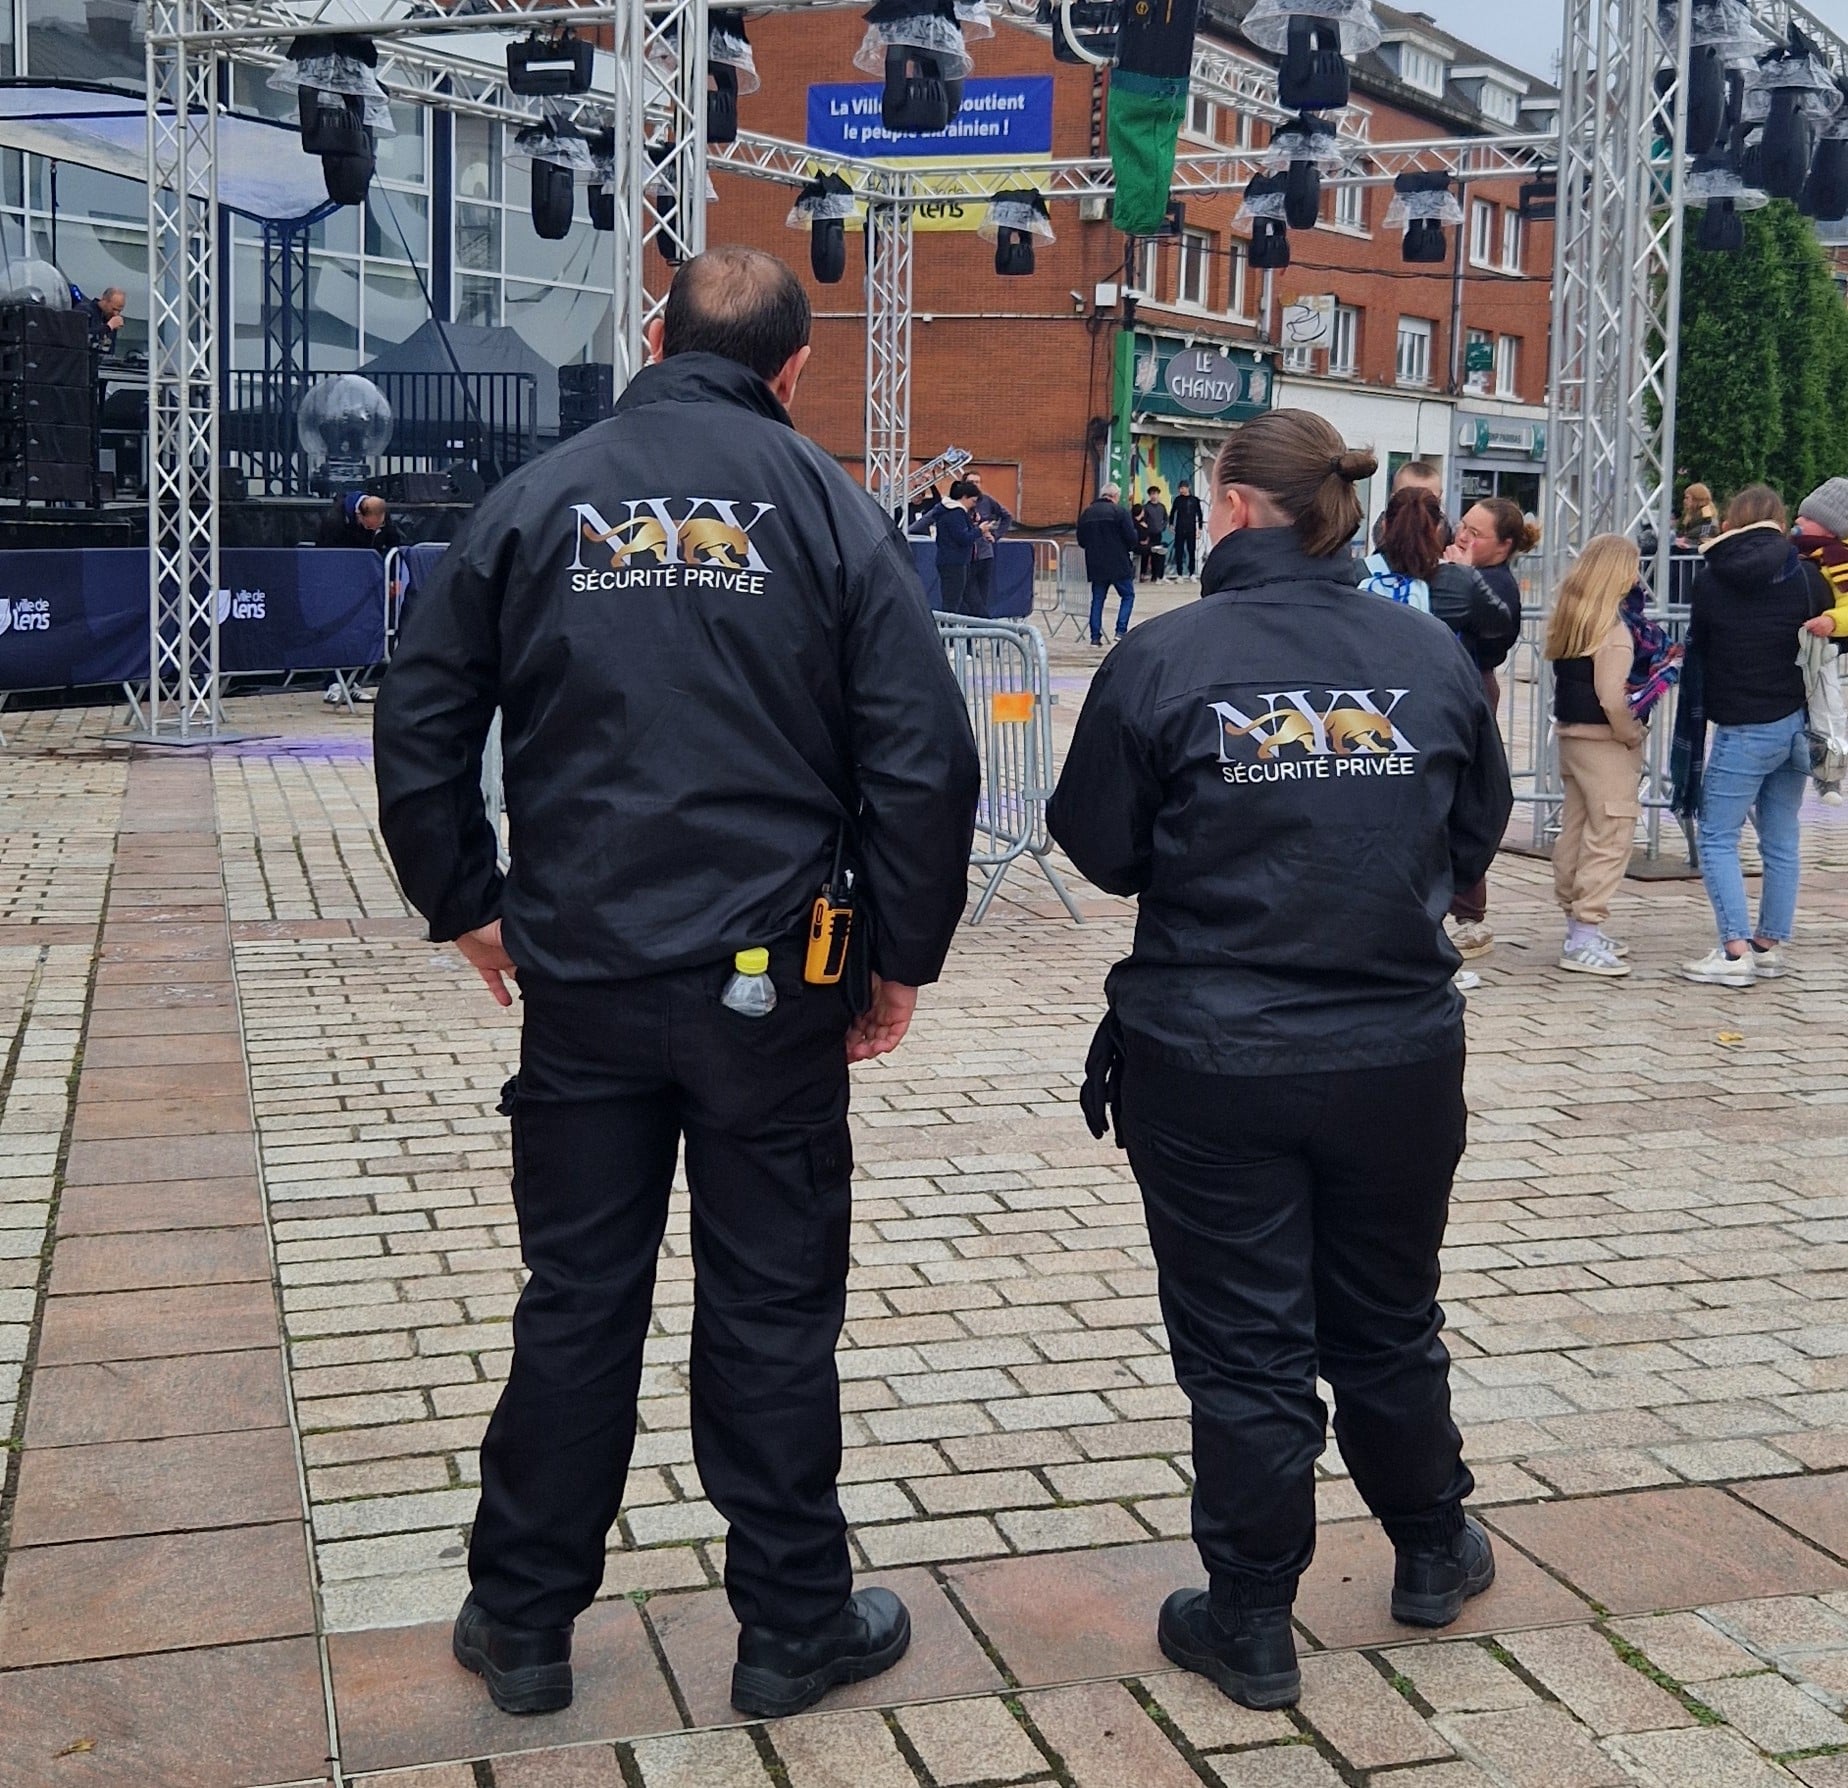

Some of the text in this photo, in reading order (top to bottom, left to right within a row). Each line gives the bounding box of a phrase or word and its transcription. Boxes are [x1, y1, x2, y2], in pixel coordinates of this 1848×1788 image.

[830, 99, 849, 116] La
[959, 93, 1025, 112] outient
[843, 123, 858, 140] le
[1196, 351, 1213, 373] LE
[1171, 376, 1235, 402] CHANZY
[566, 497, 777, 573] NYX
[571, 565, 765, 595] SÉCURITÉ PRIVÉE
[35, 597, 50, 611] de
[252, 589, 266, 602] de
[1206, 689, 1420, 763] NYX
[1222, 753, 1415, 784] SÉCURITÉ PRIVÉE
